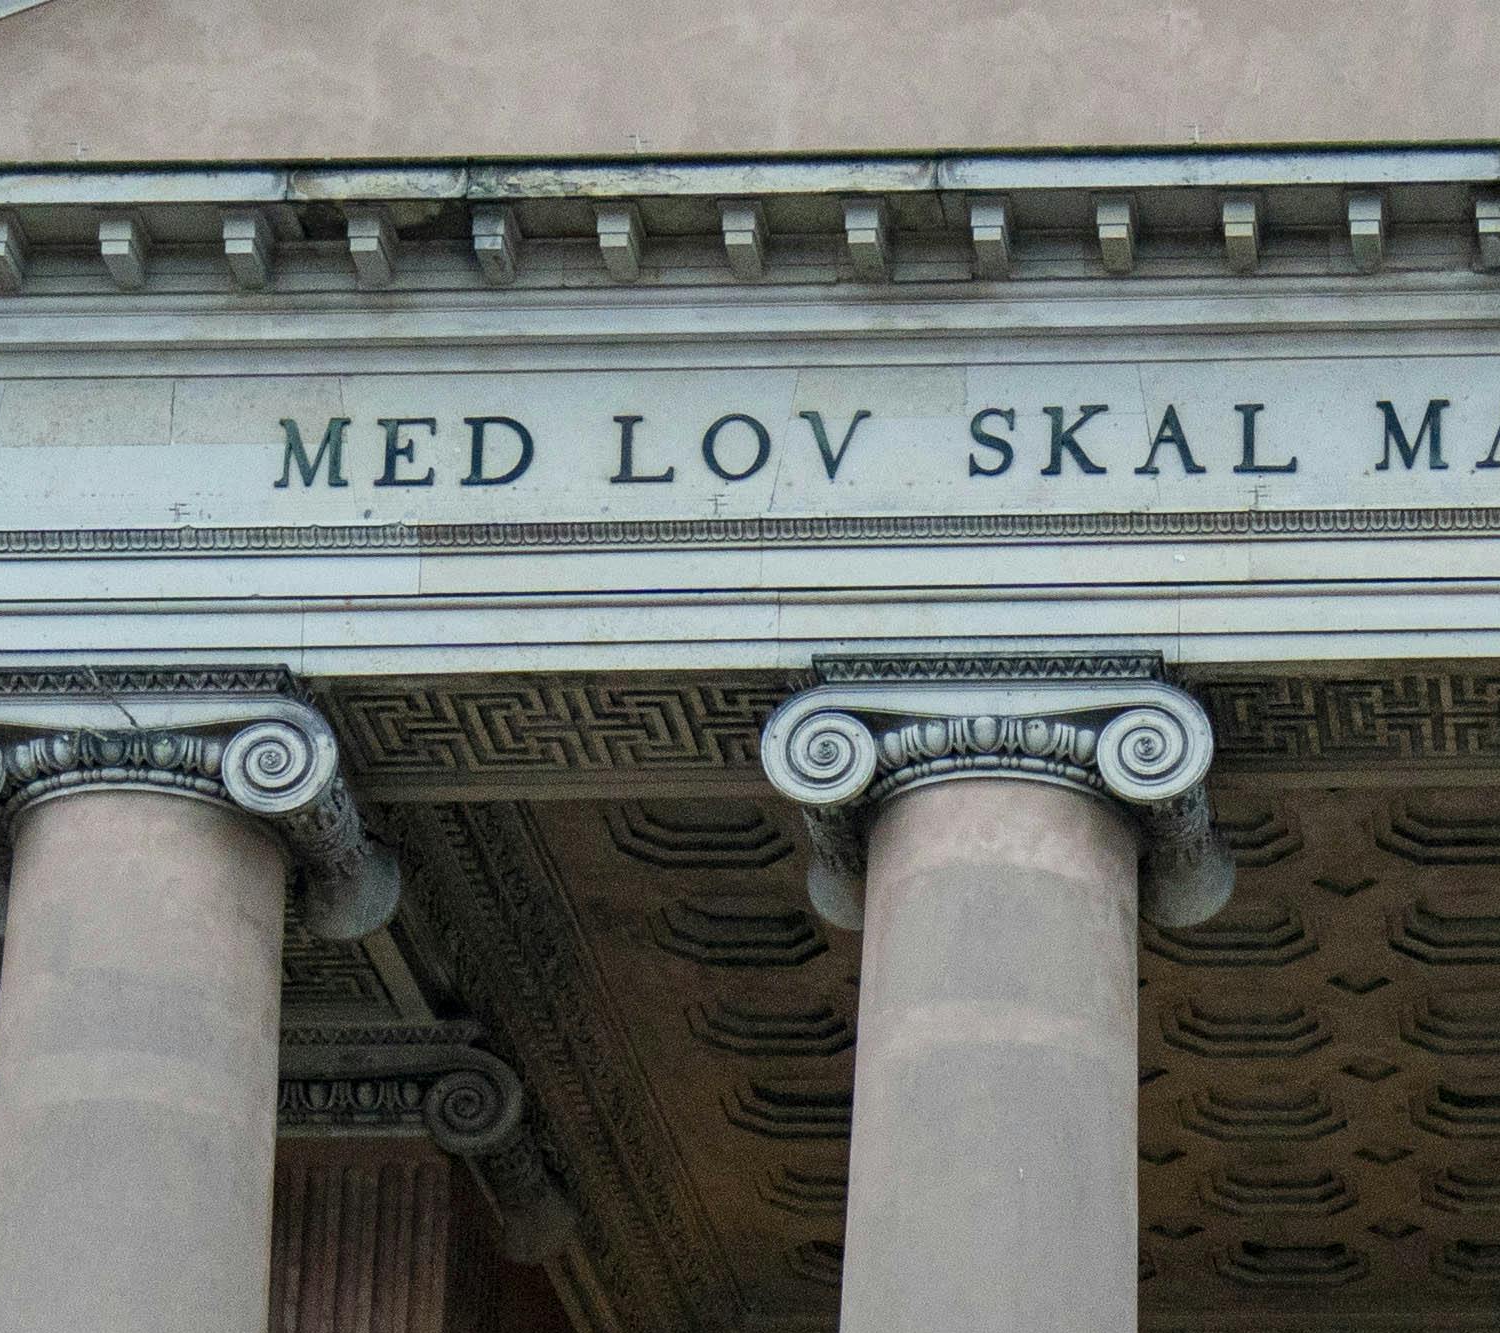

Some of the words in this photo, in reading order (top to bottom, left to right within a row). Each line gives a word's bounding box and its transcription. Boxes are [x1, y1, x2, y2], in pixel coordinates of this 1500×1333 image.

[274, 416, 534, 488] MED
[609, 410, 872, 485] LOV
[969, 404, 1298, 477] SKAL
